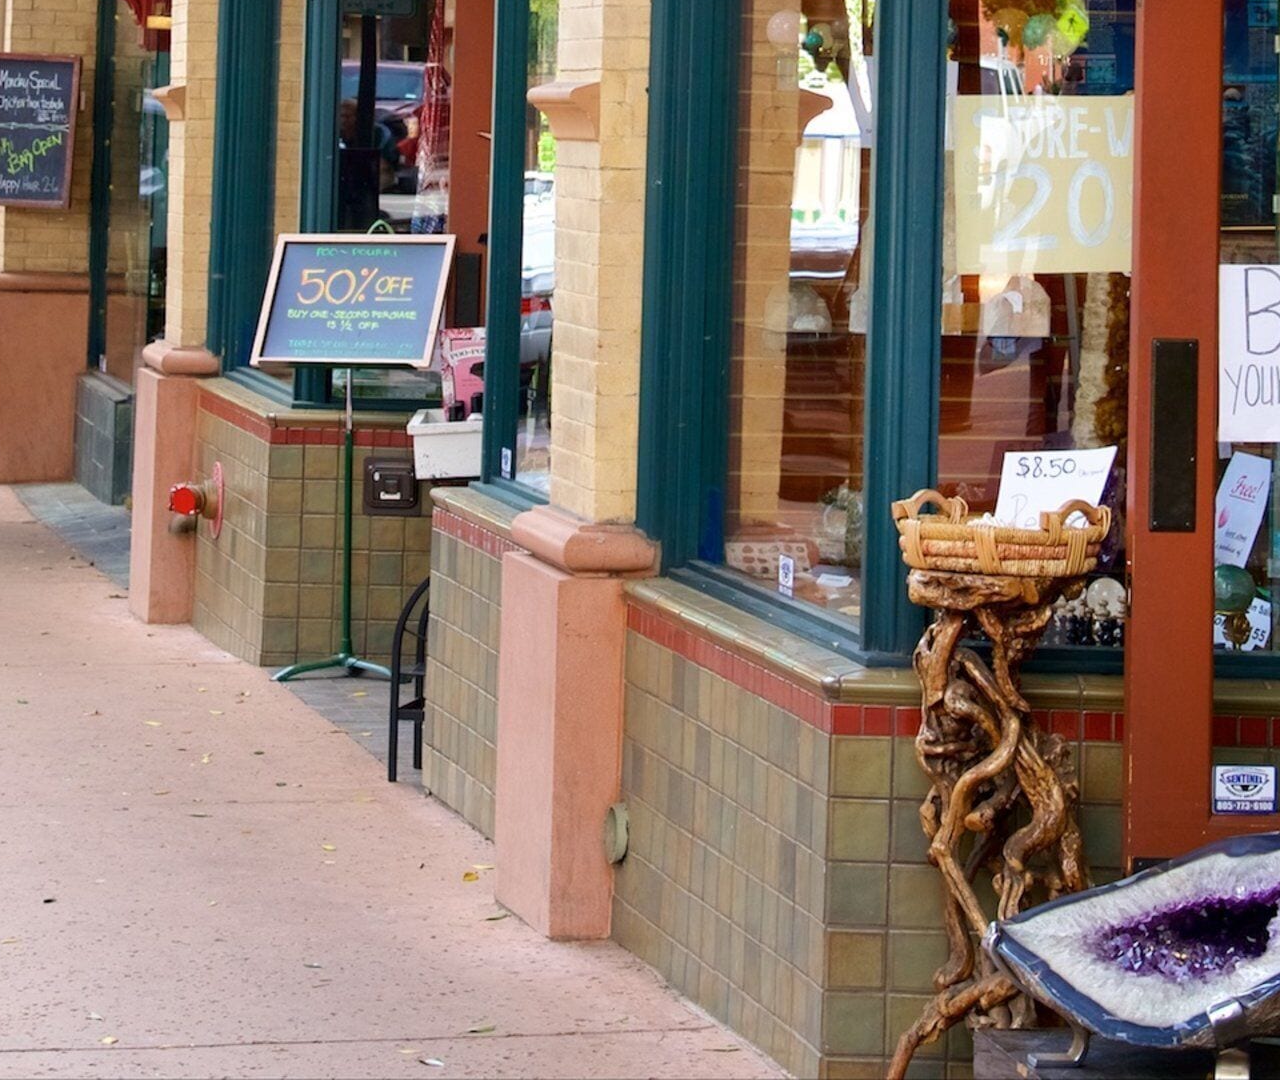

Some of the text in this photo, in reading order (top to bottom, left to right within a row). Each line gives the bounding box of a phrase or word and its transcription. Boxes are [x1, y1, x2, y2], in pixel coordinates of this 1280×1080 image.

[296, 267, 414, 305] 50% OFF
[287, 309, 308, 319] BUY
[1015, 456, 1077, 478] $8.50
[1231, 475, 1265, 499] Free!
